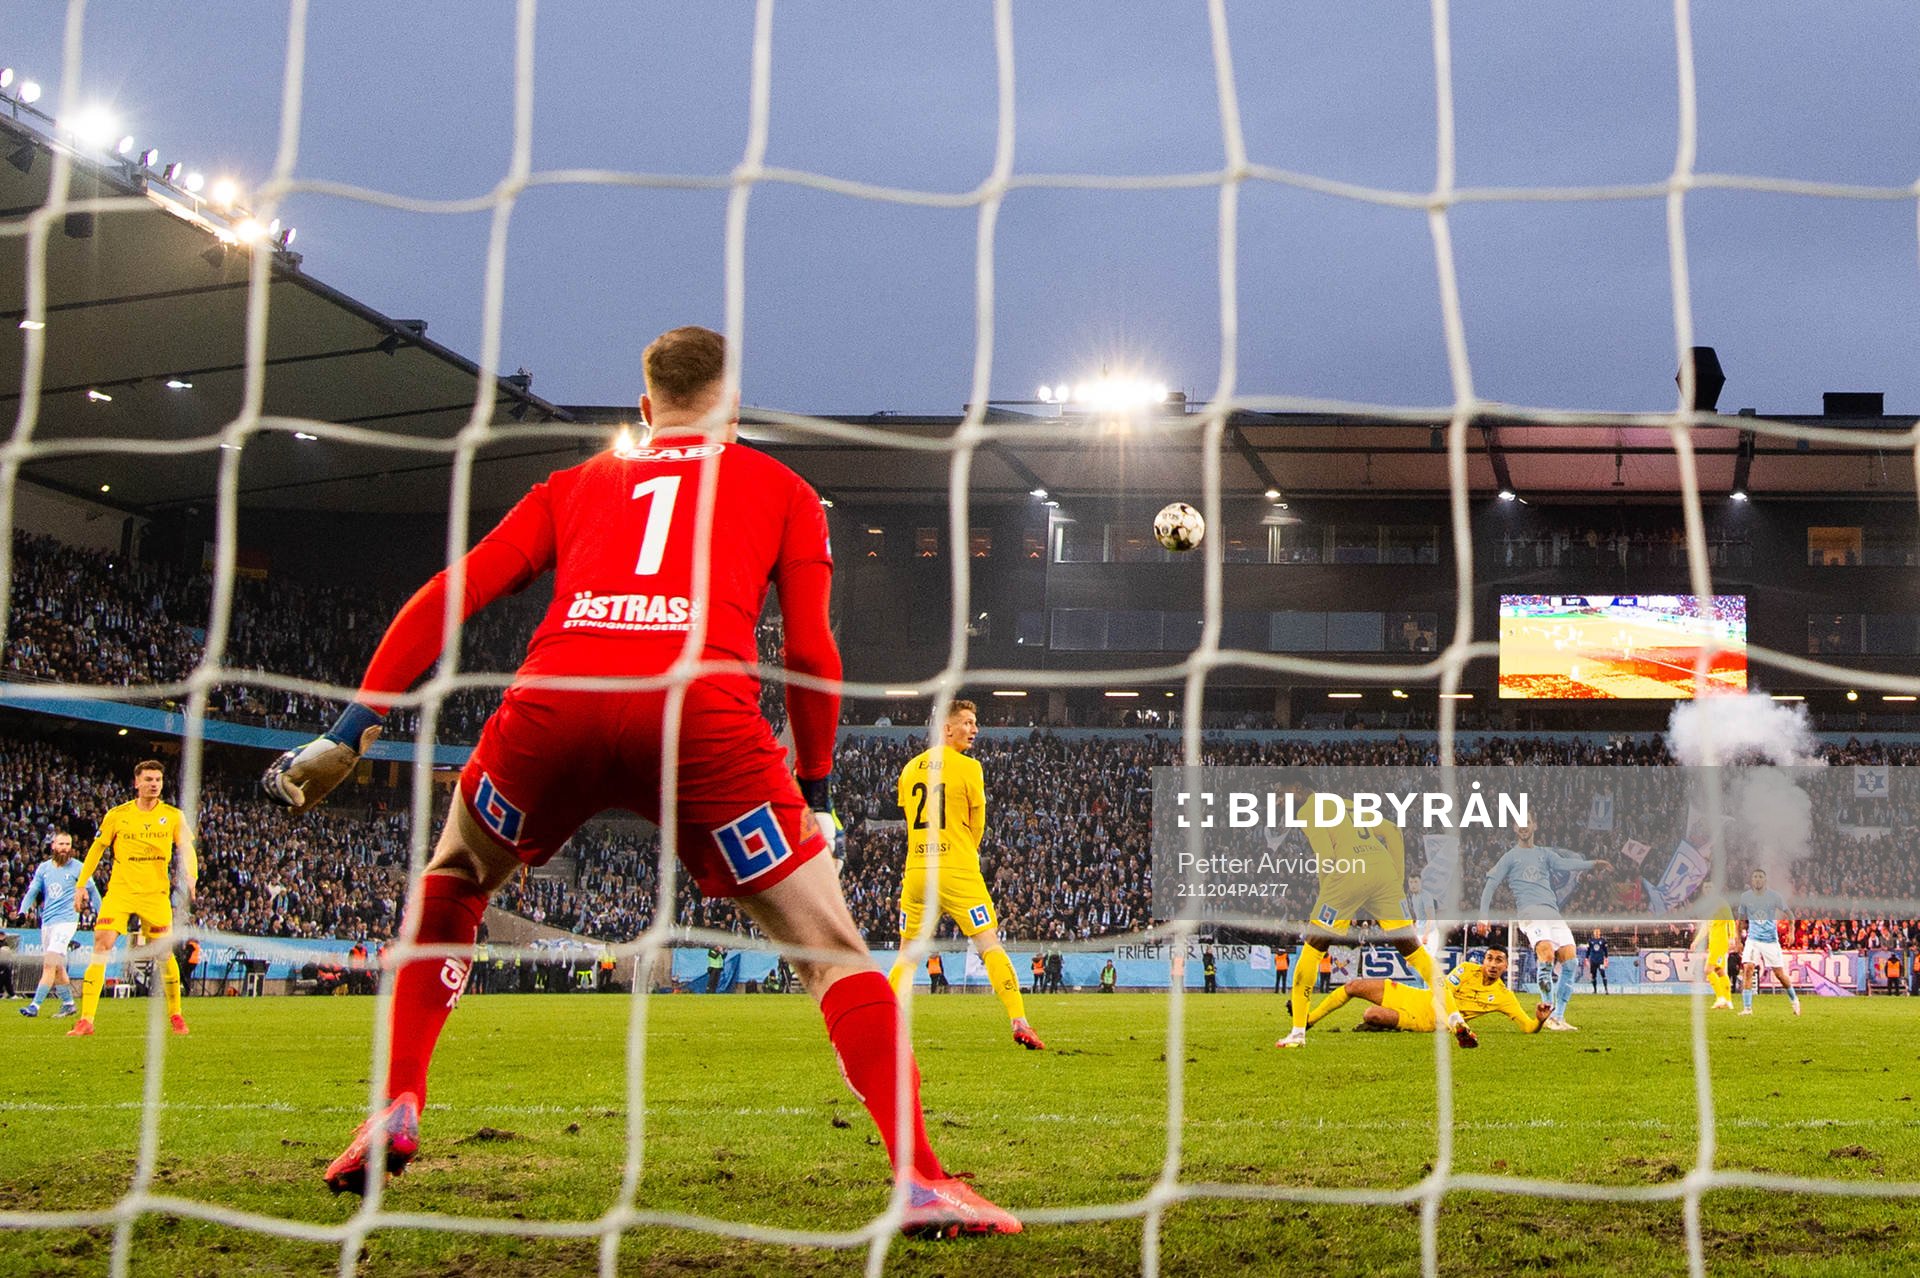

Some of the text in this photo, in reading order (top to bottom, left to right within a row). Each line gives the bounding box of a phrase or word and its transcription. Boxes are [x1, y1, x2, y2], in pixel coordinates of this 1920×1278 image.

[629, 447, 716, 459] EAB
[631, 475, 682, 575] 1
[567, 590, 689, 623] ÖSTRAS
[912, 782, 946, 830] 21
[1118, 944, 1247, 960] FRIHET FR TRAS
